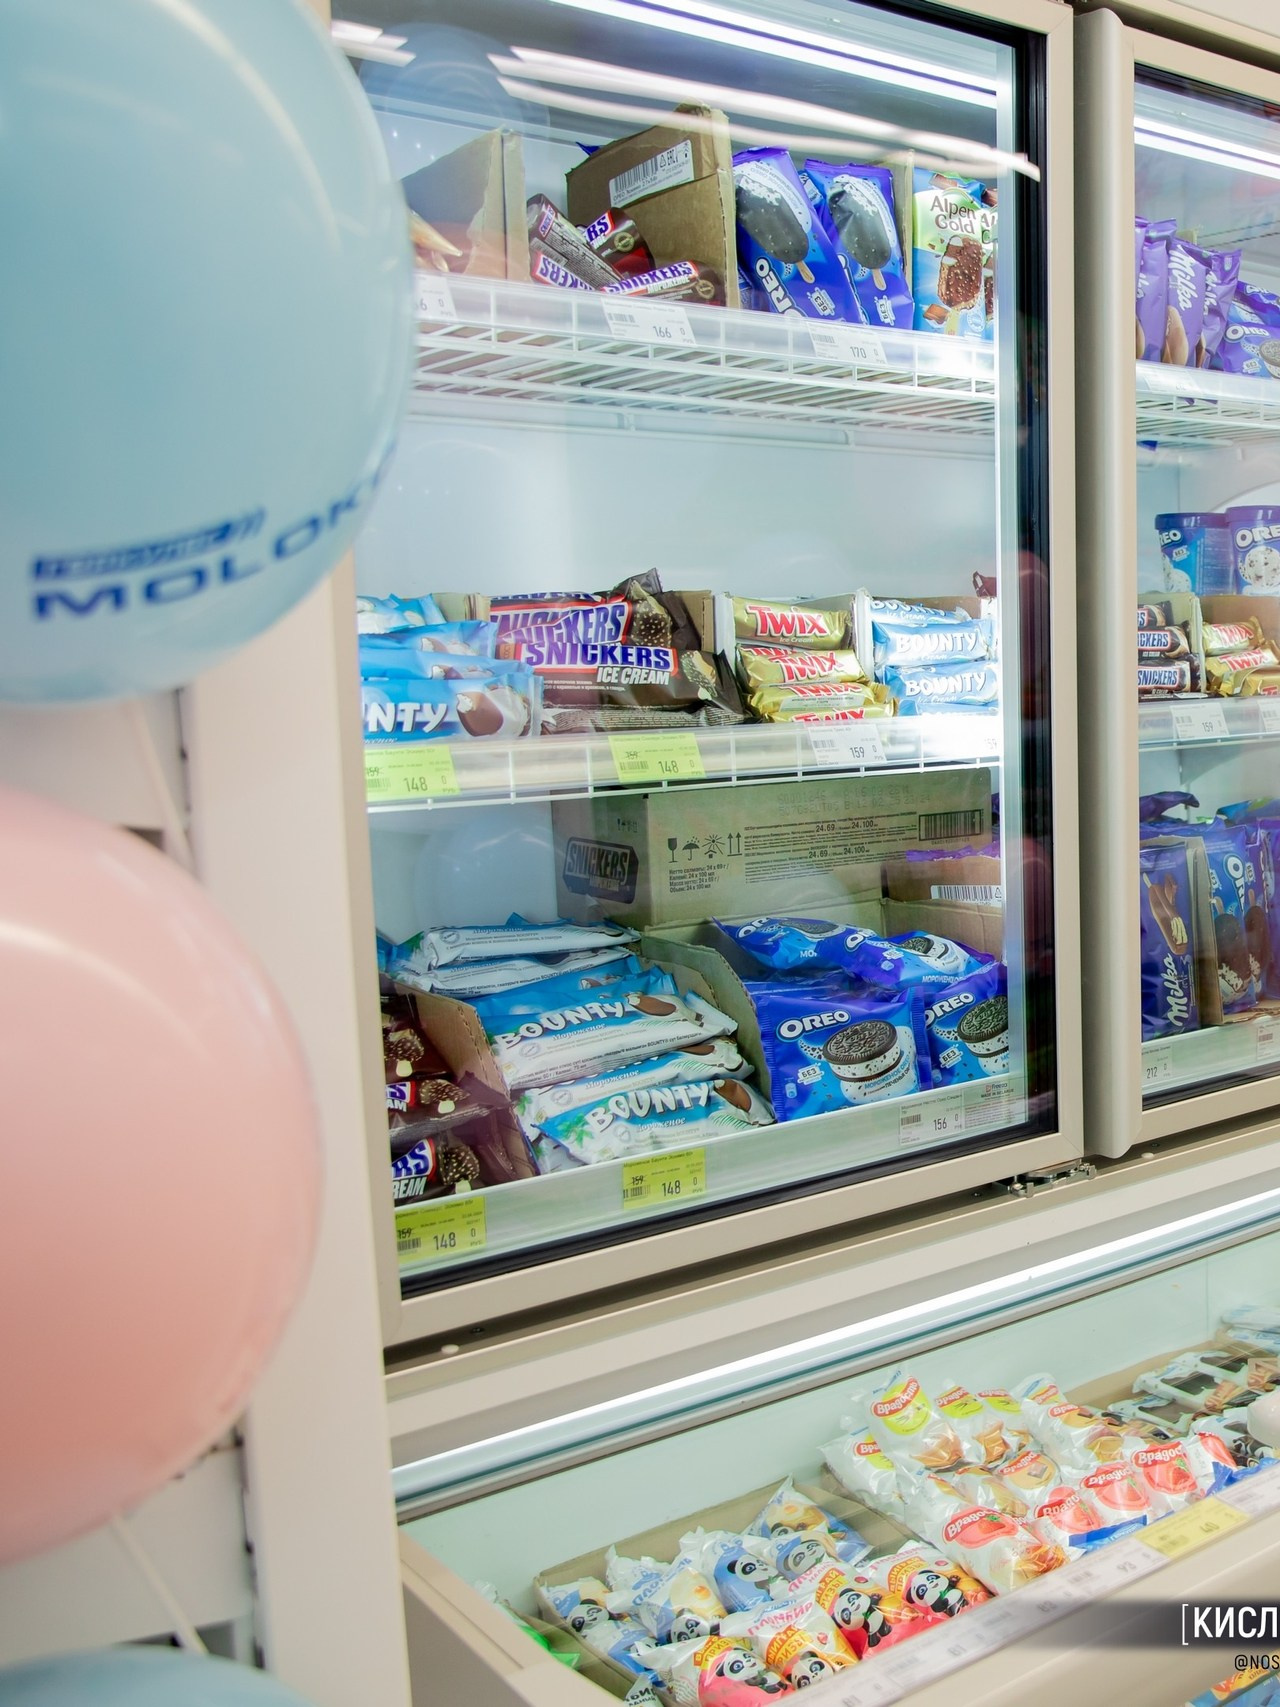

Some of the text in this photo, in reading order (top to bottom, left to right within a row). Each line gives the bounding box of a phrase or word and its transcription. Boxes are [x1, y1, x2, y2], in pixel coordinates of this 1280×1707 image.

[930, 195, 977, 220] Alpen
[935, 212, 976, 235] Gold
[606, 260, 692, 295] SNICKERS
[1168, 244, 1198, 311] Milka
[652, 325, 672, 339] 166
[850, 345, 867, 359] 170
[747, 604, 828, 638] TWIX
[897, 631, 978, 653] BOUNTY
[525, 641, 672, 670] SNICKERS
[771, 651, 844, 683] TWIX
[597, 666, 671, 686] ICE CREAM
[905, 671, 987, 698] BOUNTY
[850, 746, 865, 759] 159
[658, 760, 679, 774] 148
[403, 775, 428, 793] 148
[567, 842, 629, 879] SNICKERS
[1161, 952, 1190, 1027] Milka
[925, 993, 975, 1026] OREO
[495, 1001, 626, 1049] BOUNTY
[552, 1022, 607, 1042] Мороженое
[778, 1010, 850, 1040] OREO
[585, 1068, 641, 1090] Мороженое
[1146, 1066, 1158, 1079] 212
[585, 1081, 711, 1133] BOUNTY
[933, 1117, 948, 1131] 156
[661, 1179, 681, 1197] 148
[433, 1232, 457, 1251] 148
